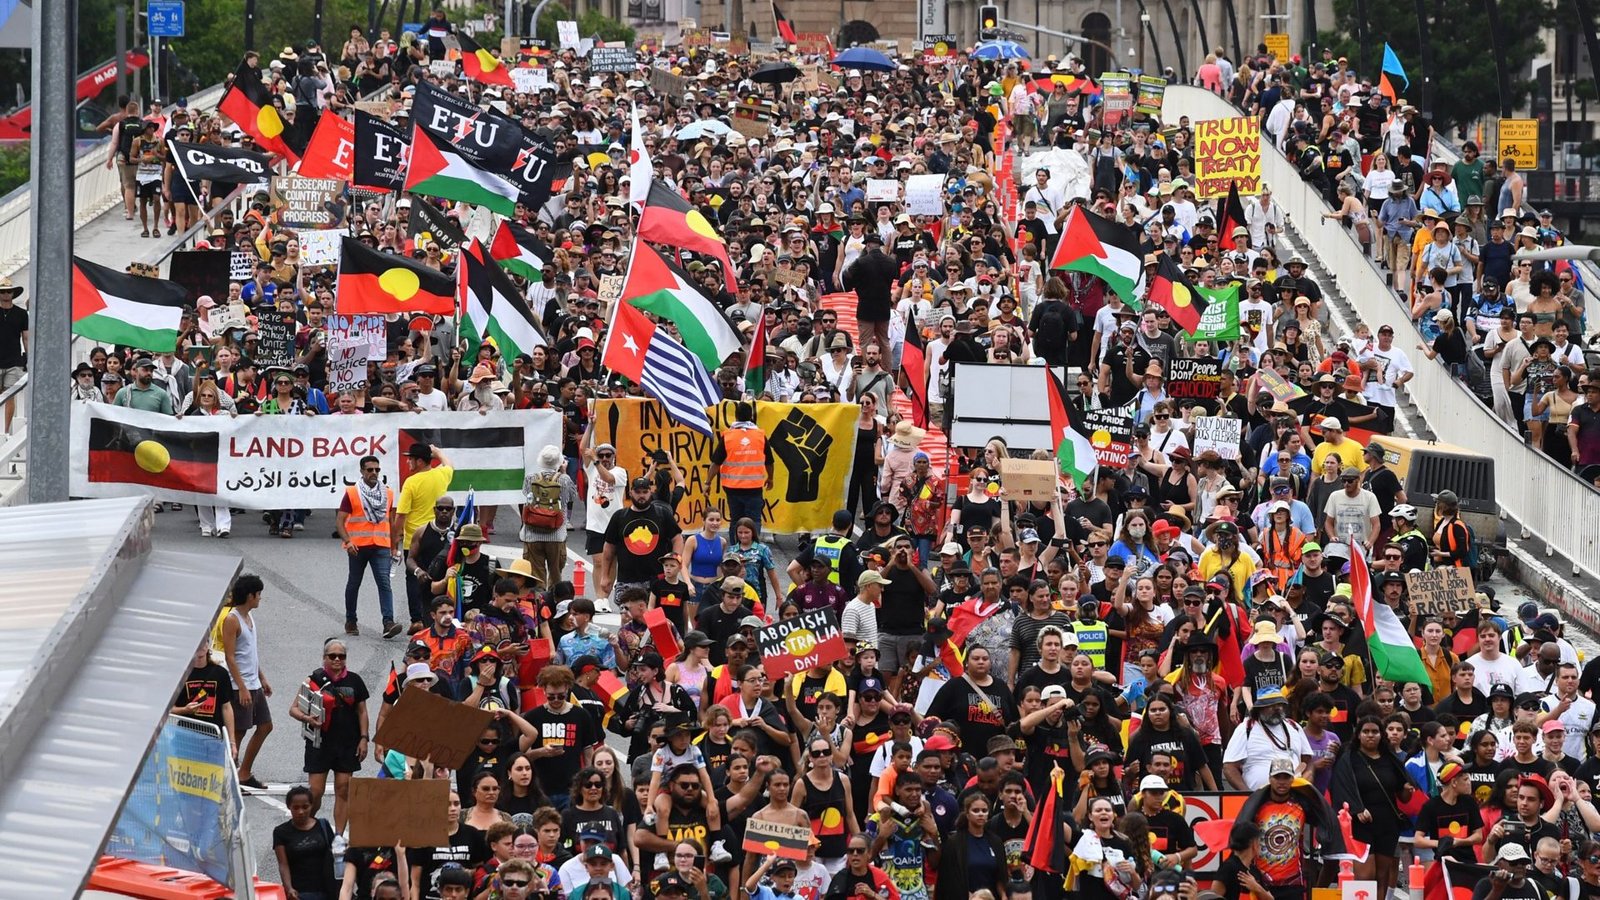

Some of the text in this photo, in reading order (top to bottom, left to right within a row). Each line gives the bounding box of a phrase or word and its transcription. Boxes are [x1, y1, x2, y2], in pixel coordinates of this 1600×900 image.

[429, 104, 499, 148] ETU
[1195, 116, 1260, 138] TRUTH
[1200, 136, 1260, 157] NOW
[1196, 154, 1261, 178] TREATY
[276, 178, 337, 192] WE DESECRATE
[285, 190, 332, 202] COUNTRY &
[289, 200, 320, 211] CALL IT
[283, 211, 330, 224] PROGRESS
[602, 276, 624, 287] FUC
[327, 315, 385, 331] NO PRIDE
[340, 346, 356, 360] NO
[1170, 360, 1192, 370] HOT
[337, 369, 354, 383] NO
[329, 379, 366, 392] Peace
[1167, 381, 1220, 399] GENOCIDE
[1085, 412, 1125, 426] NO PRIDE
[1196, 416, 1238, 433] ONLY DUMB
[229, 433, 388, 458] LAND BACK
[1111, 443, 1125, 452] YOU
[226, 466, 282, 492] الأرض
[288, 468, 337, 494] إعادة
[817, 548, 838, 557] POLICE
[1409, 568, 1460, 583] PARDON ME
[1419, 580, 1445, 593] BEING
[1447, 578, 1468, 589] BORN
[1415, 597, 1477, 615] RACISTS
[759, 610, 828, 644] ABOLISH
[763, 624, 840, 659] AUSTRALIA
[1078, 632, 1104, 640] POLICE
[794, 653, 820, 671] DAY
[542, 722, 566, 738] BIG
